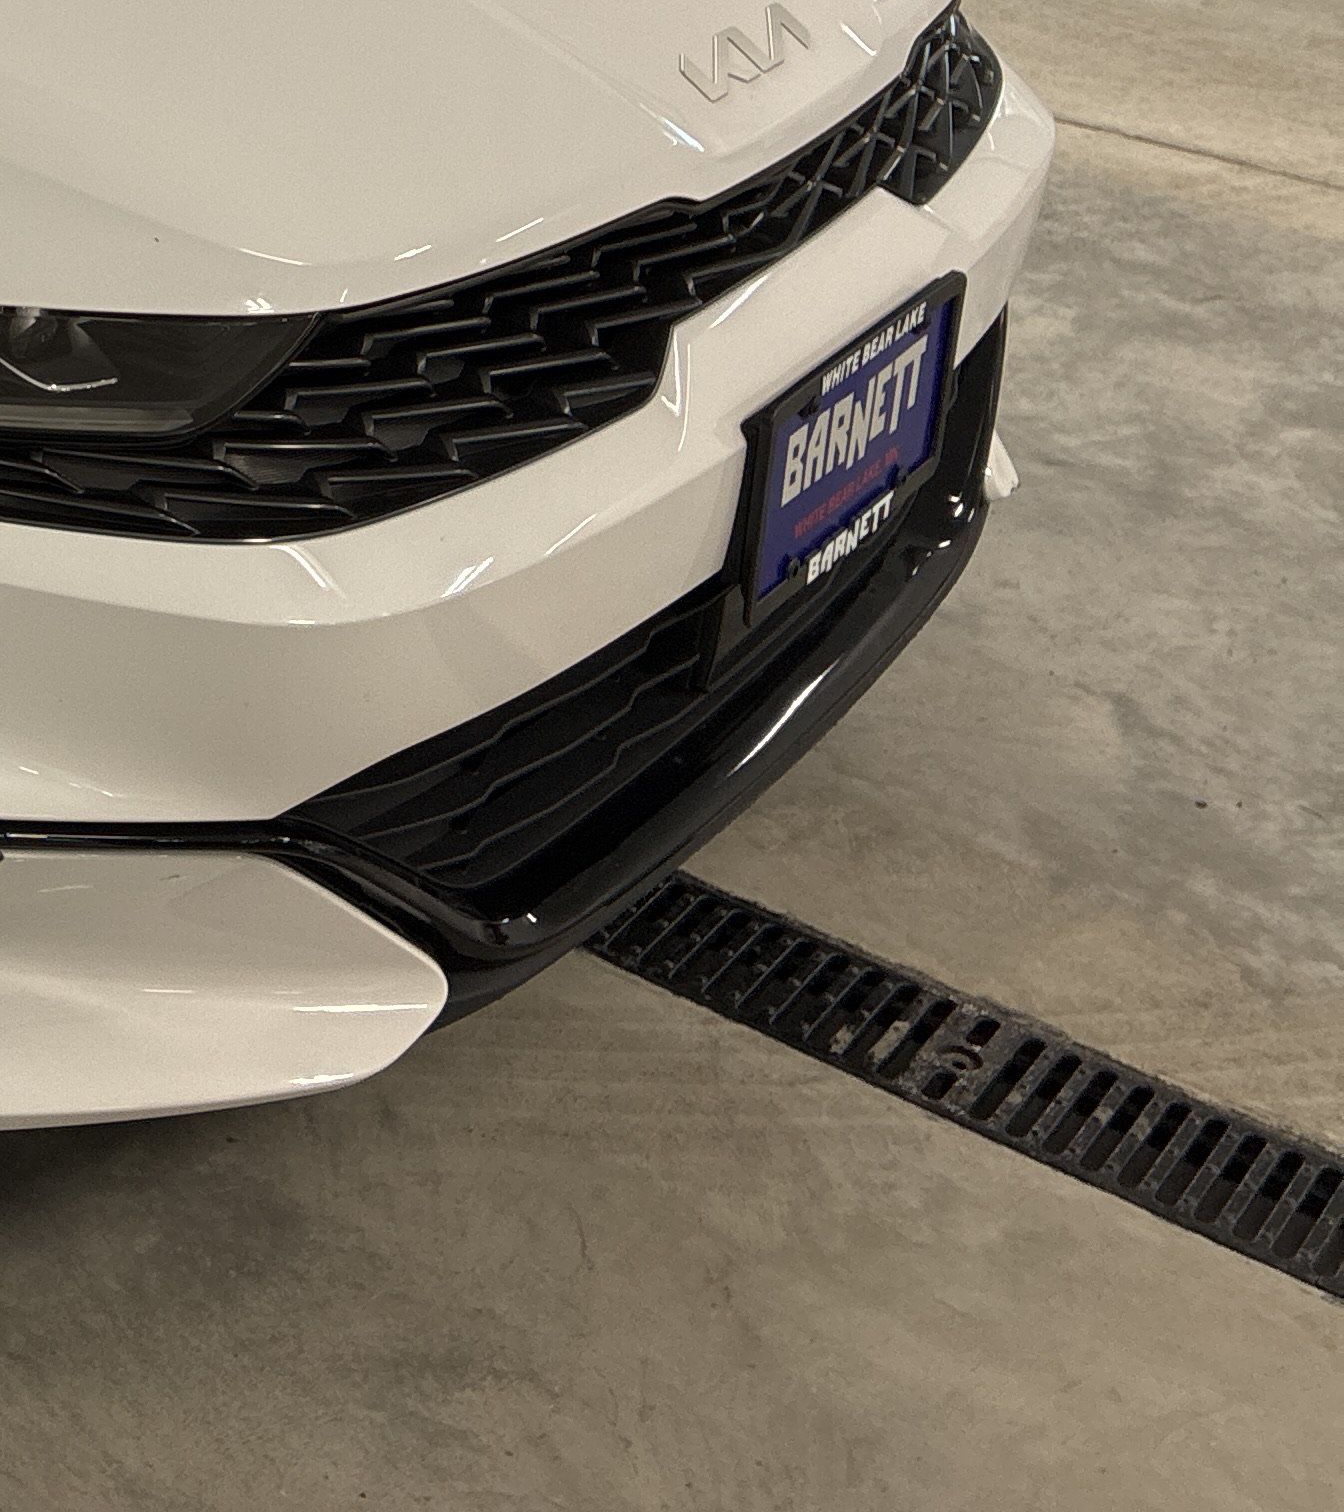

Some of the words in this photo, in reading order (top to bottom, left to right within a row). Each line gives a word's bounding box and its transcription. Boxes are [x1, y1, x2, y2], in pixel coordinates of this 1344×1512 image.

[678, 2, 811, 103] KIA
[821, 349, 861, 396] WHITE
[862, 325, 894, 367] BEAR
[895, 301, 927, 341] LAKE
[780, 334, 929, 508] BARNETT
[806, 490, 895, 586] BARNETT
